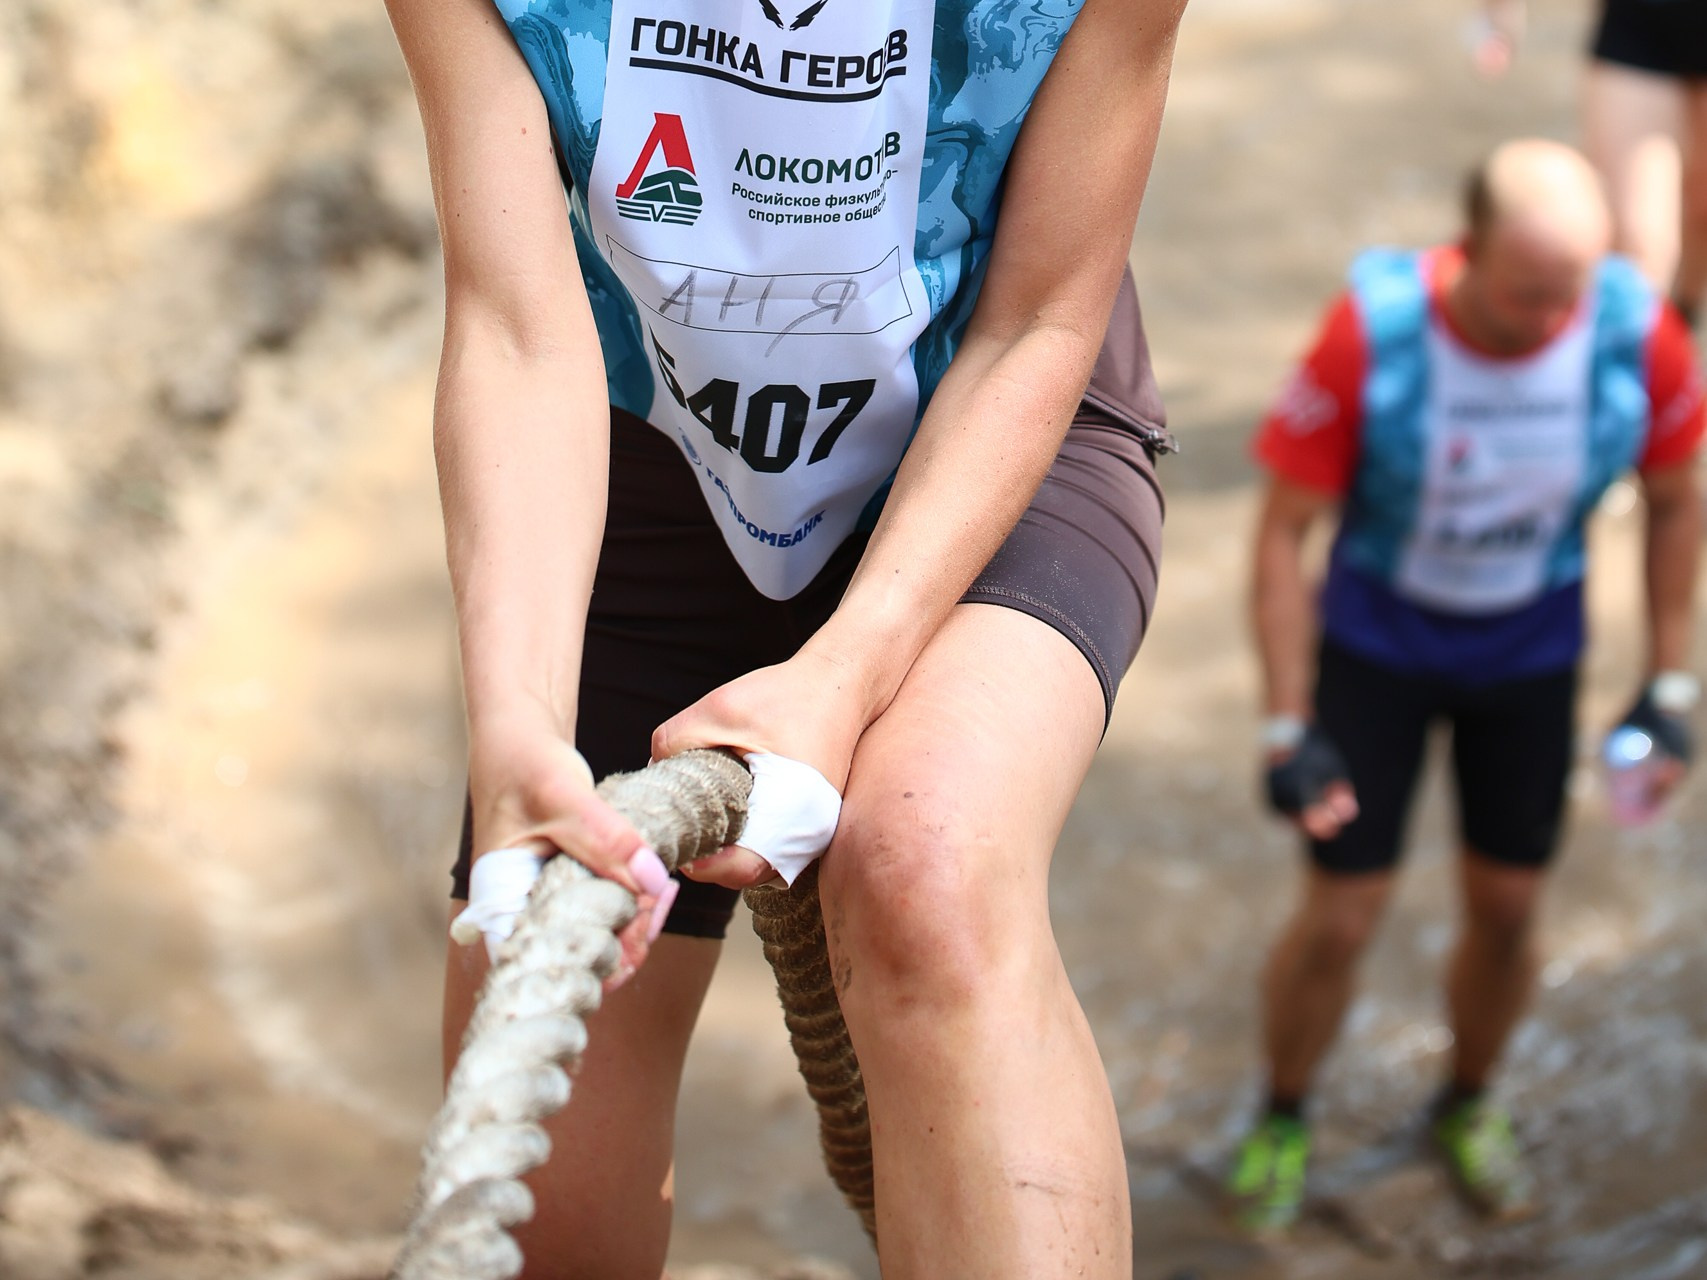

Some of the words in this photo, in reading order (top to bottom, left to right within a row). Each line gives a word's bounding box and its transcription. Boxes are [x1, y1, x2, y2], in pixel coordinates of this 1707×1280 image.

[630, 17, 764, 79] ГОНКА
[779, 29, 908, 88] ГЕРОВ
[734, 131, 901, 184] ЛОКОМОТВ
[731, 182, 821, 208] Российское
[748, 208, 842, 226] спортивное
[658, 269, 860, 358] АНЯ
[647, 321, 877, 473] 5407
[706, 467, 827, 548] ГАПРОМБАНК
